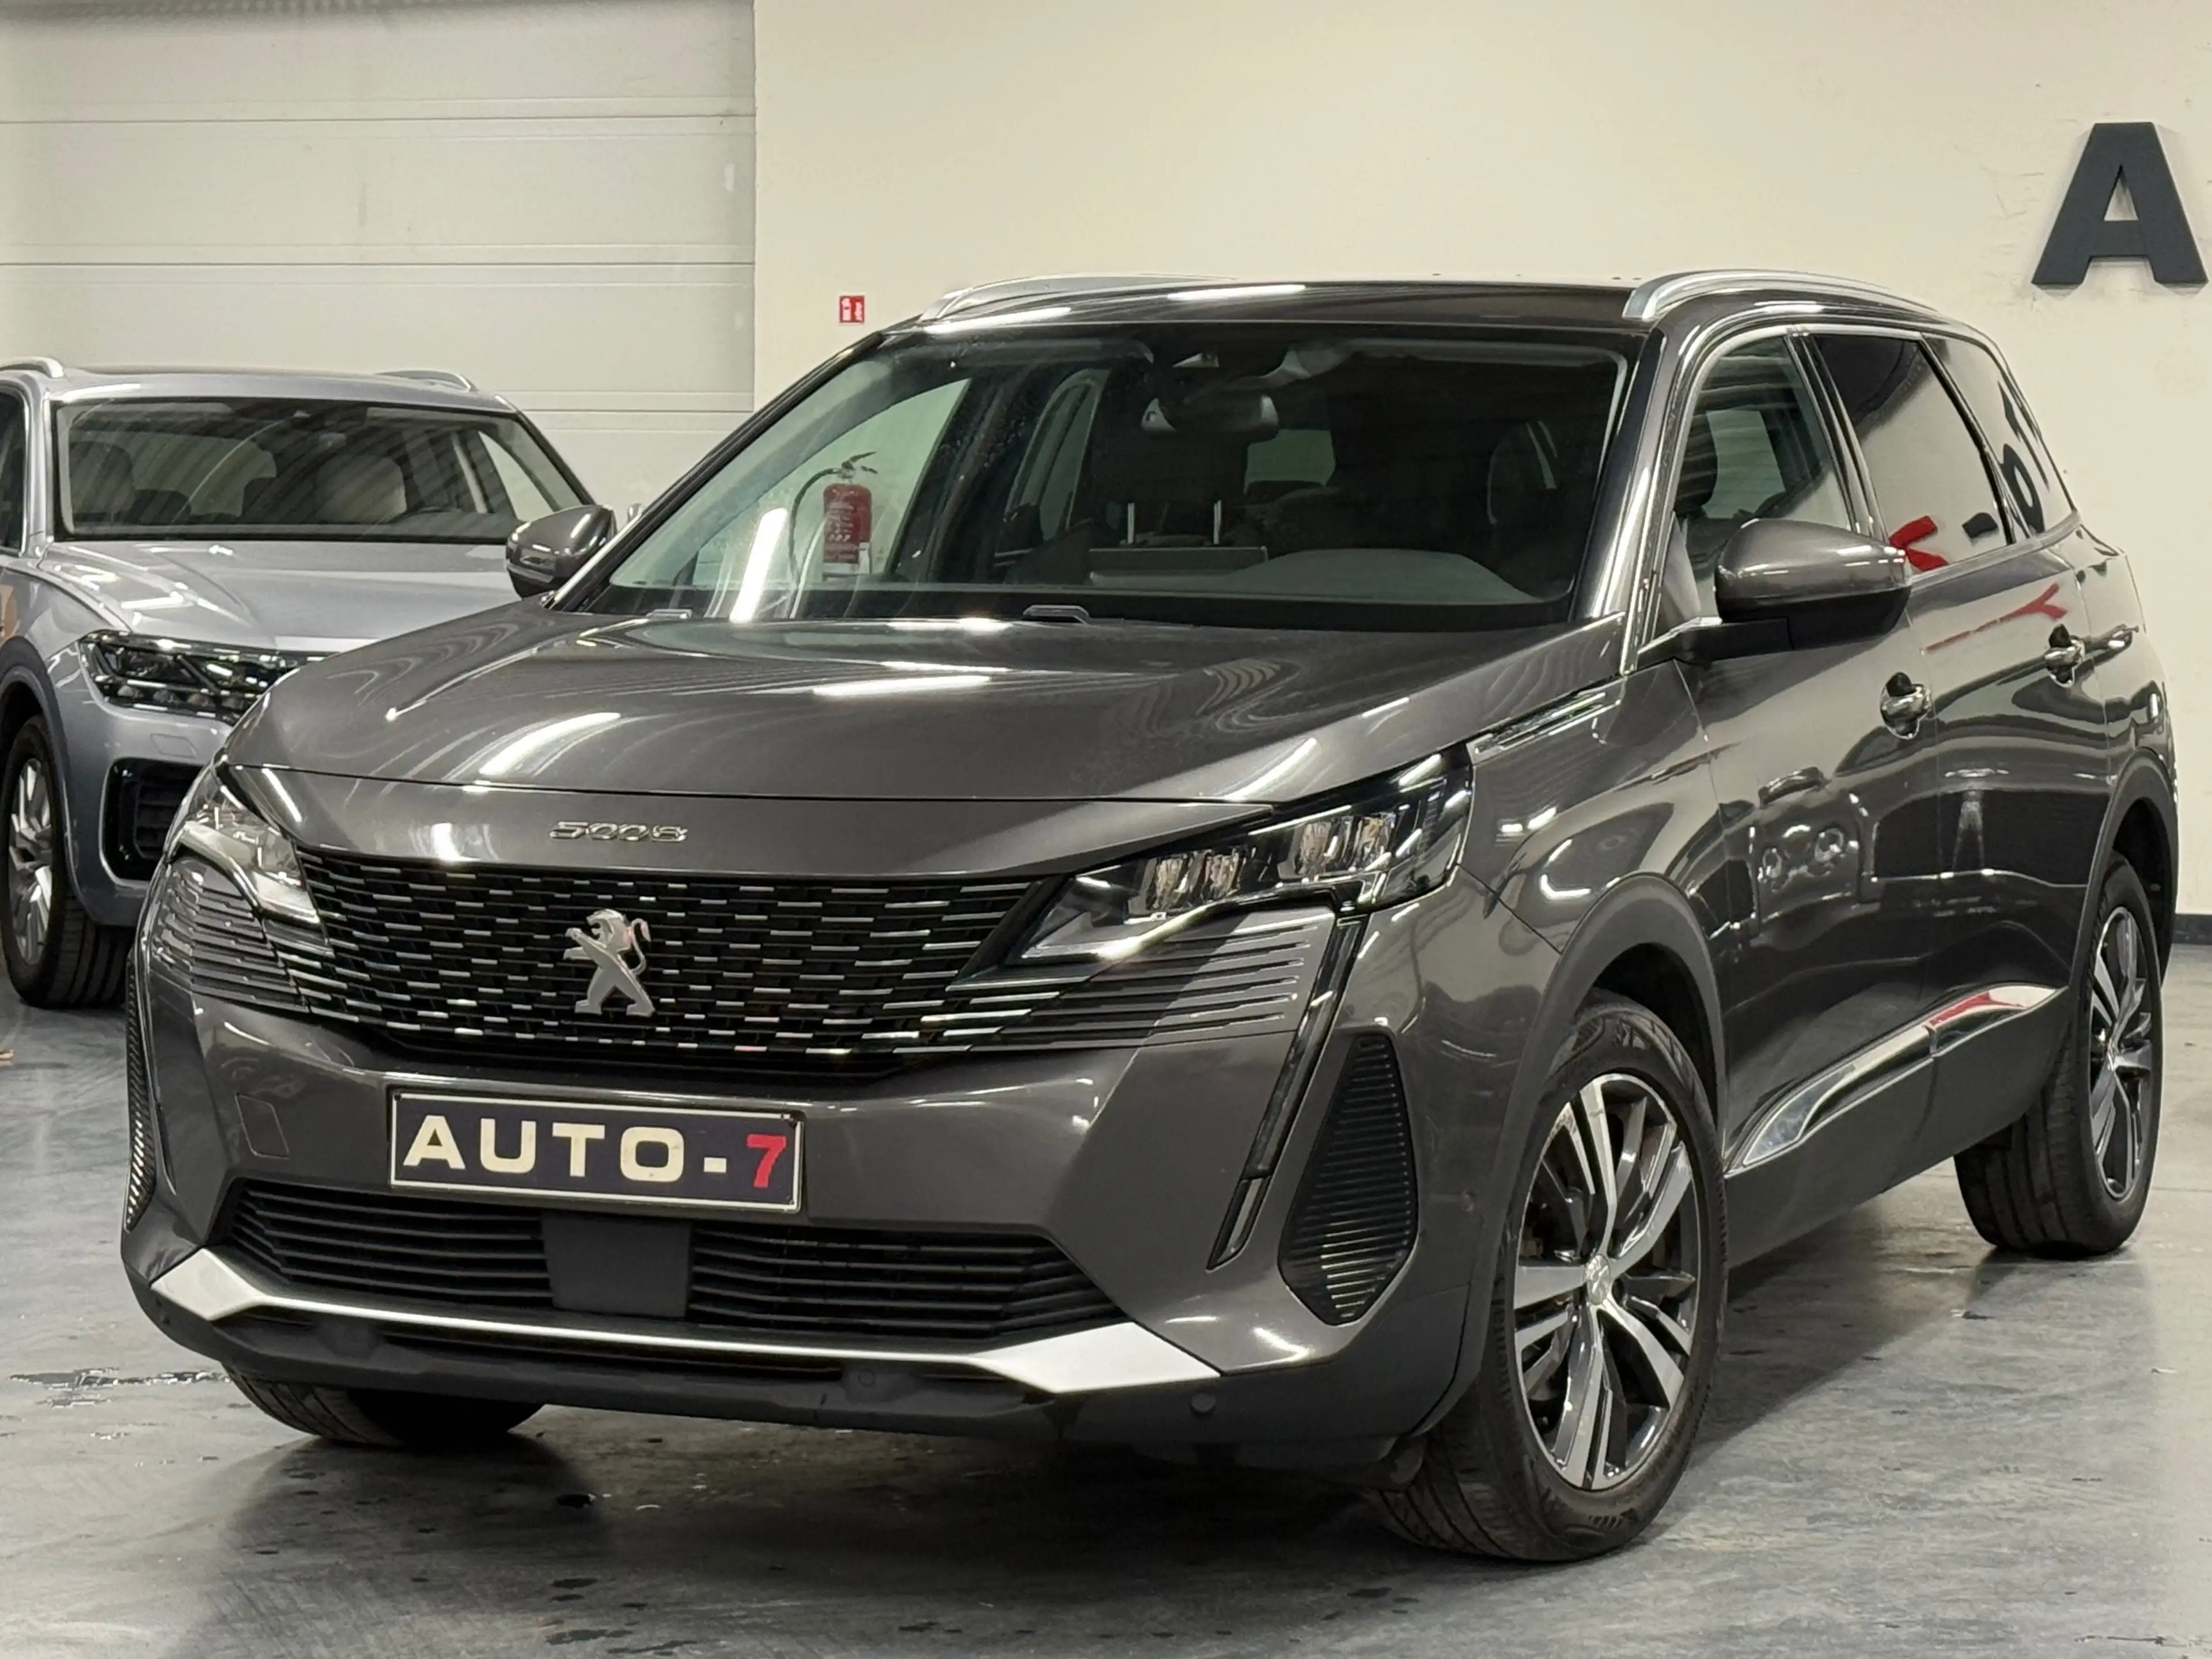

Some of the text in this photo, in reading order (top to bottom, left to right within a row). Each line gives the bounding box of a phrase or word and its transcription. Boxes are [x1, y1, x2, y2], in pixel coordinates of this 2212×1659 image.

[2031, 122, 2209, 285] A
[549, 821, 688, 842] 5008
[403, 1115, 787, 1188] AUTO-7
